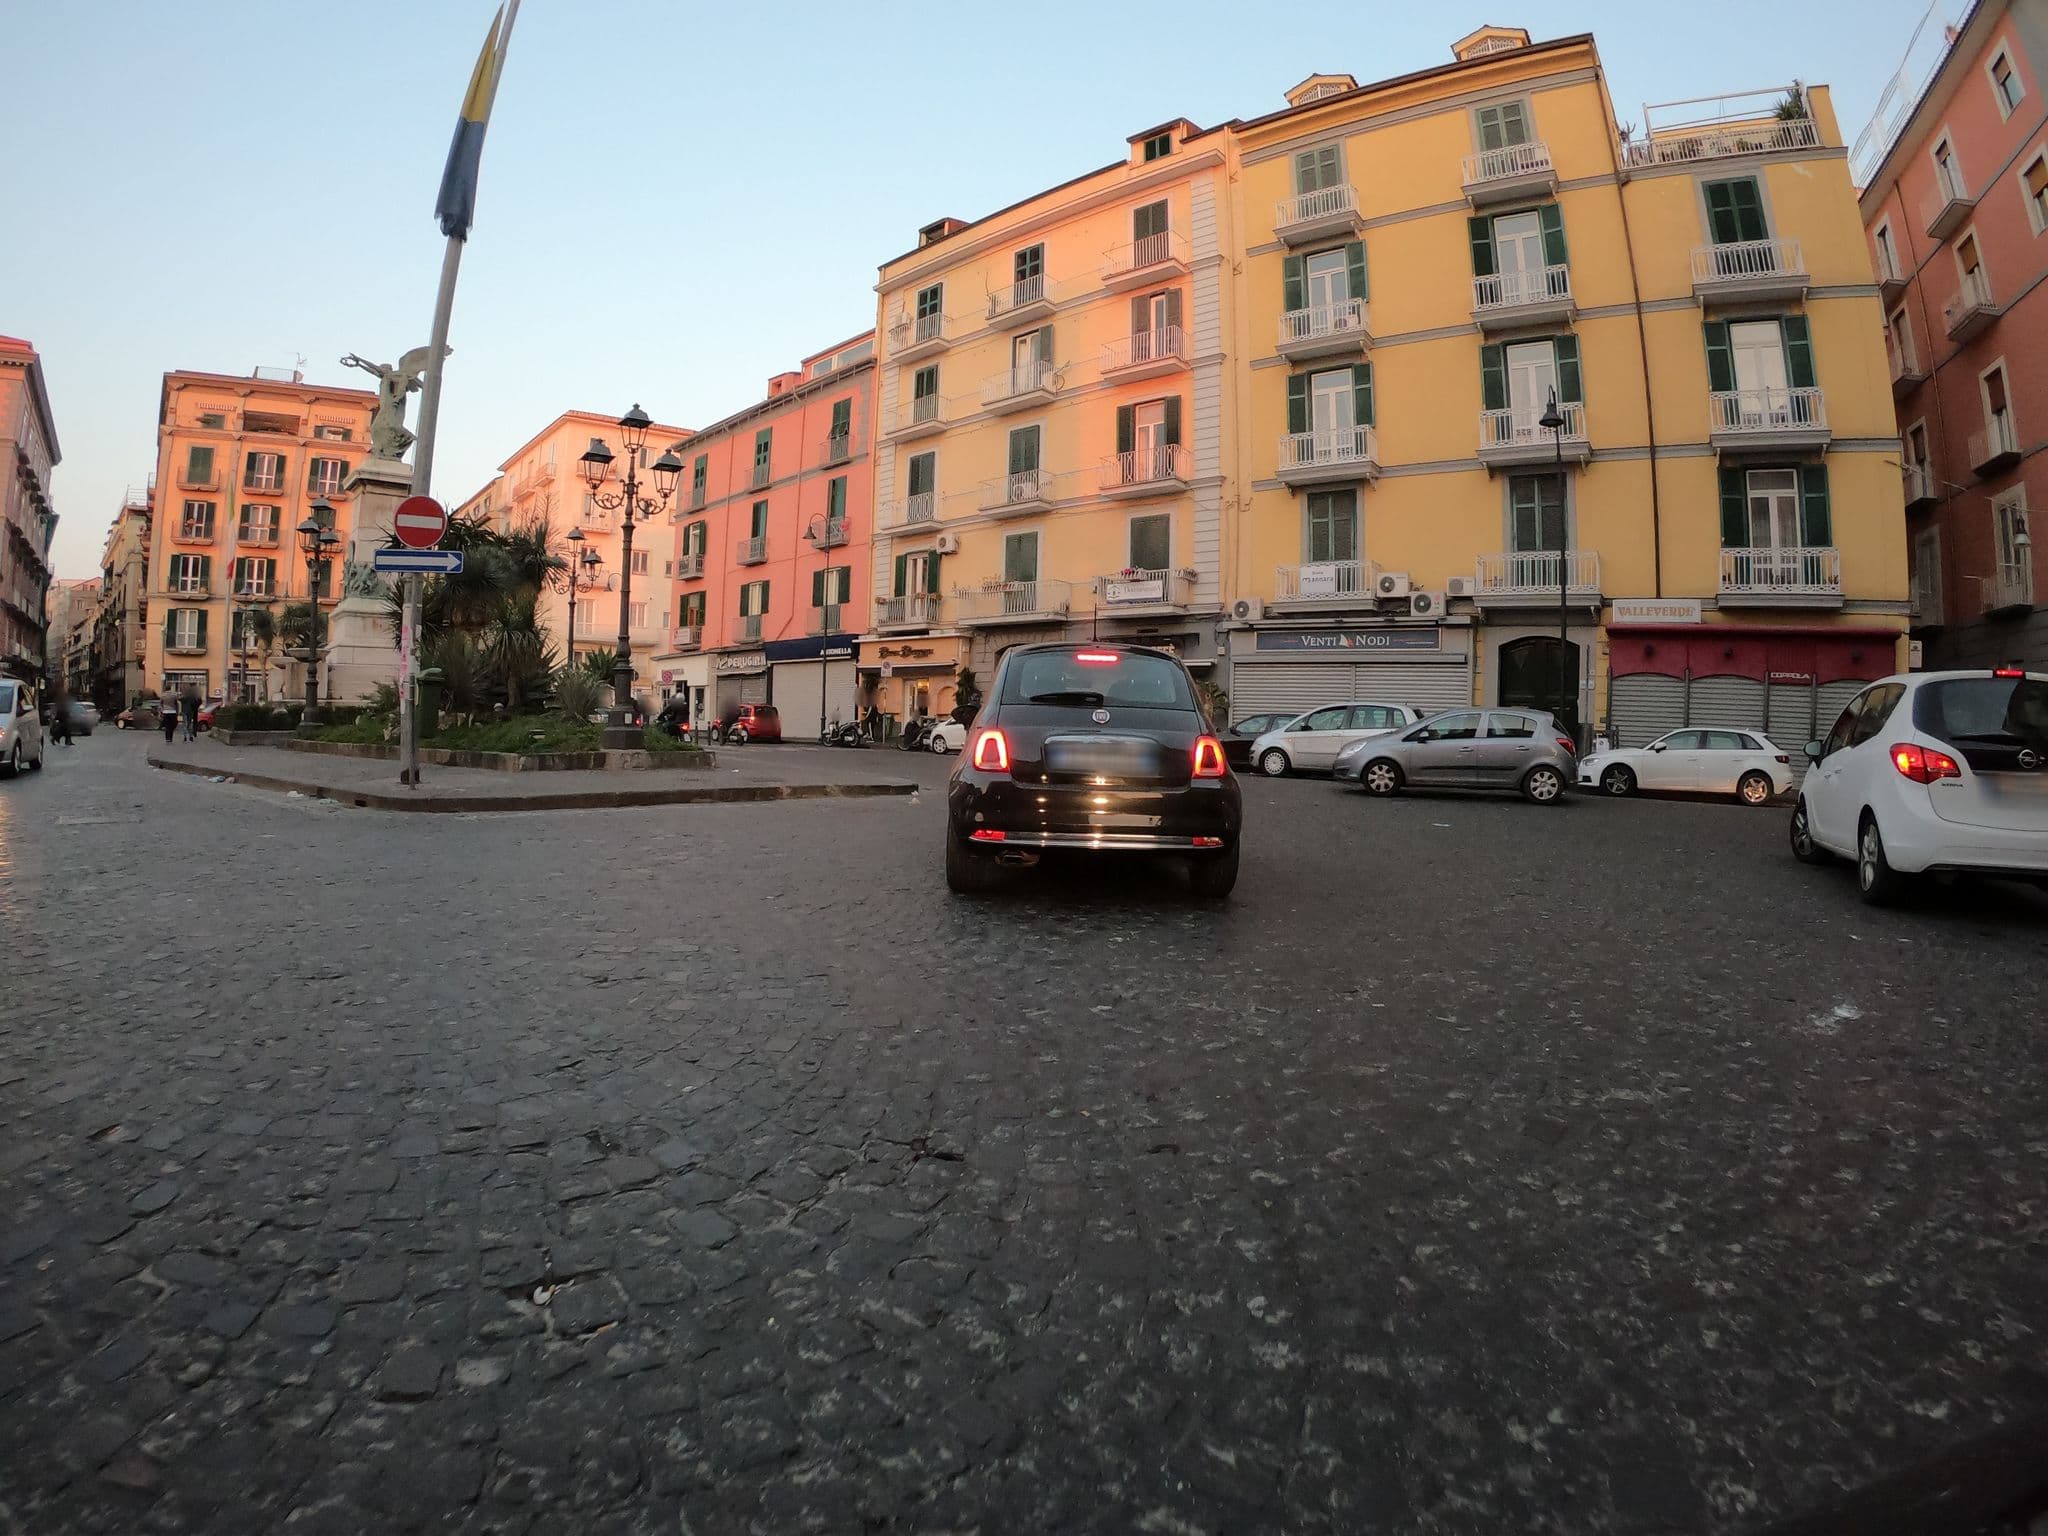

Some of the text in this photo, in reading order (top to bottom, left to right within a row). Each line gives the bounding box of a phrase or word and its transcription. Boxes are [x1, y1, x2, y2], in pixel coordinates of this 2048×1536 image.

[1617, 606, 1696, 617] VALLEVERDE
[1301, 635, 1337, 647] VENTI
[1356, 634, 1390, 646] NODI
